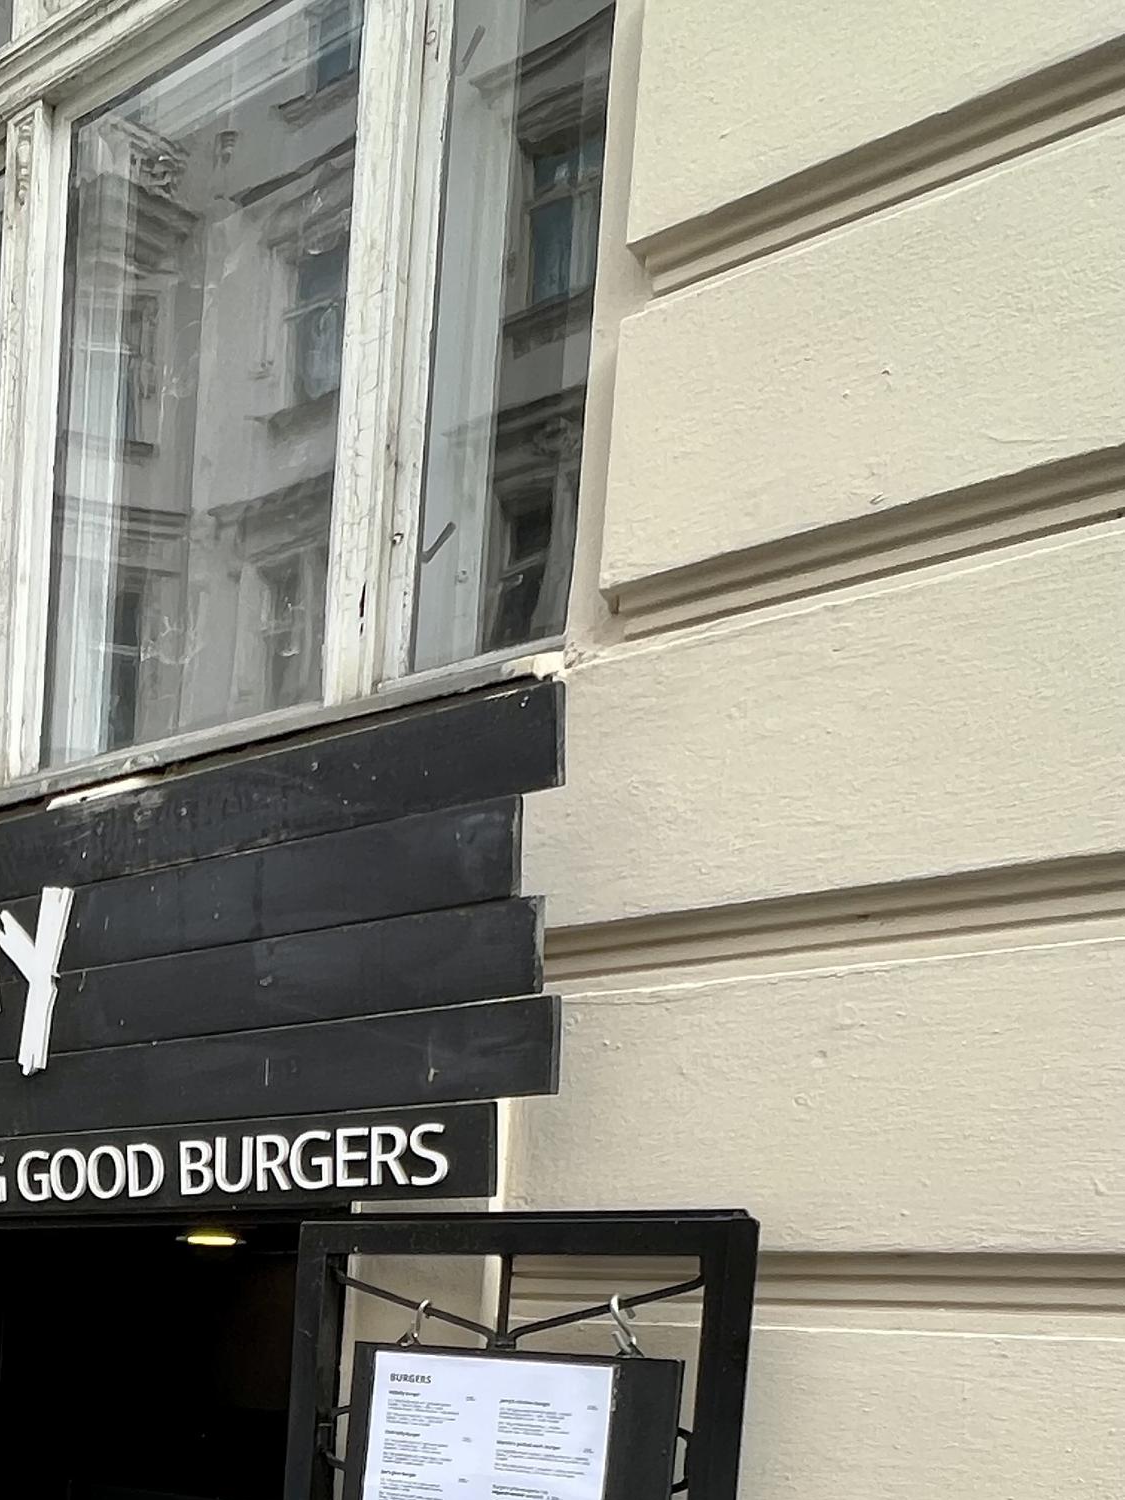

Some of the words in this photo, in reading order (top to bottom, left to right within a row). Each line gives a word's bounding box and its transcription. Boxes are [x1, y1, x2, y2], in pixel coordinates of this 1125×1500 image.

[16, 1142, 165, 1203] GOOD
[177, 1121, 450, 1196] BURGERS
[390, 1372, 432, 1384] BURGERS
